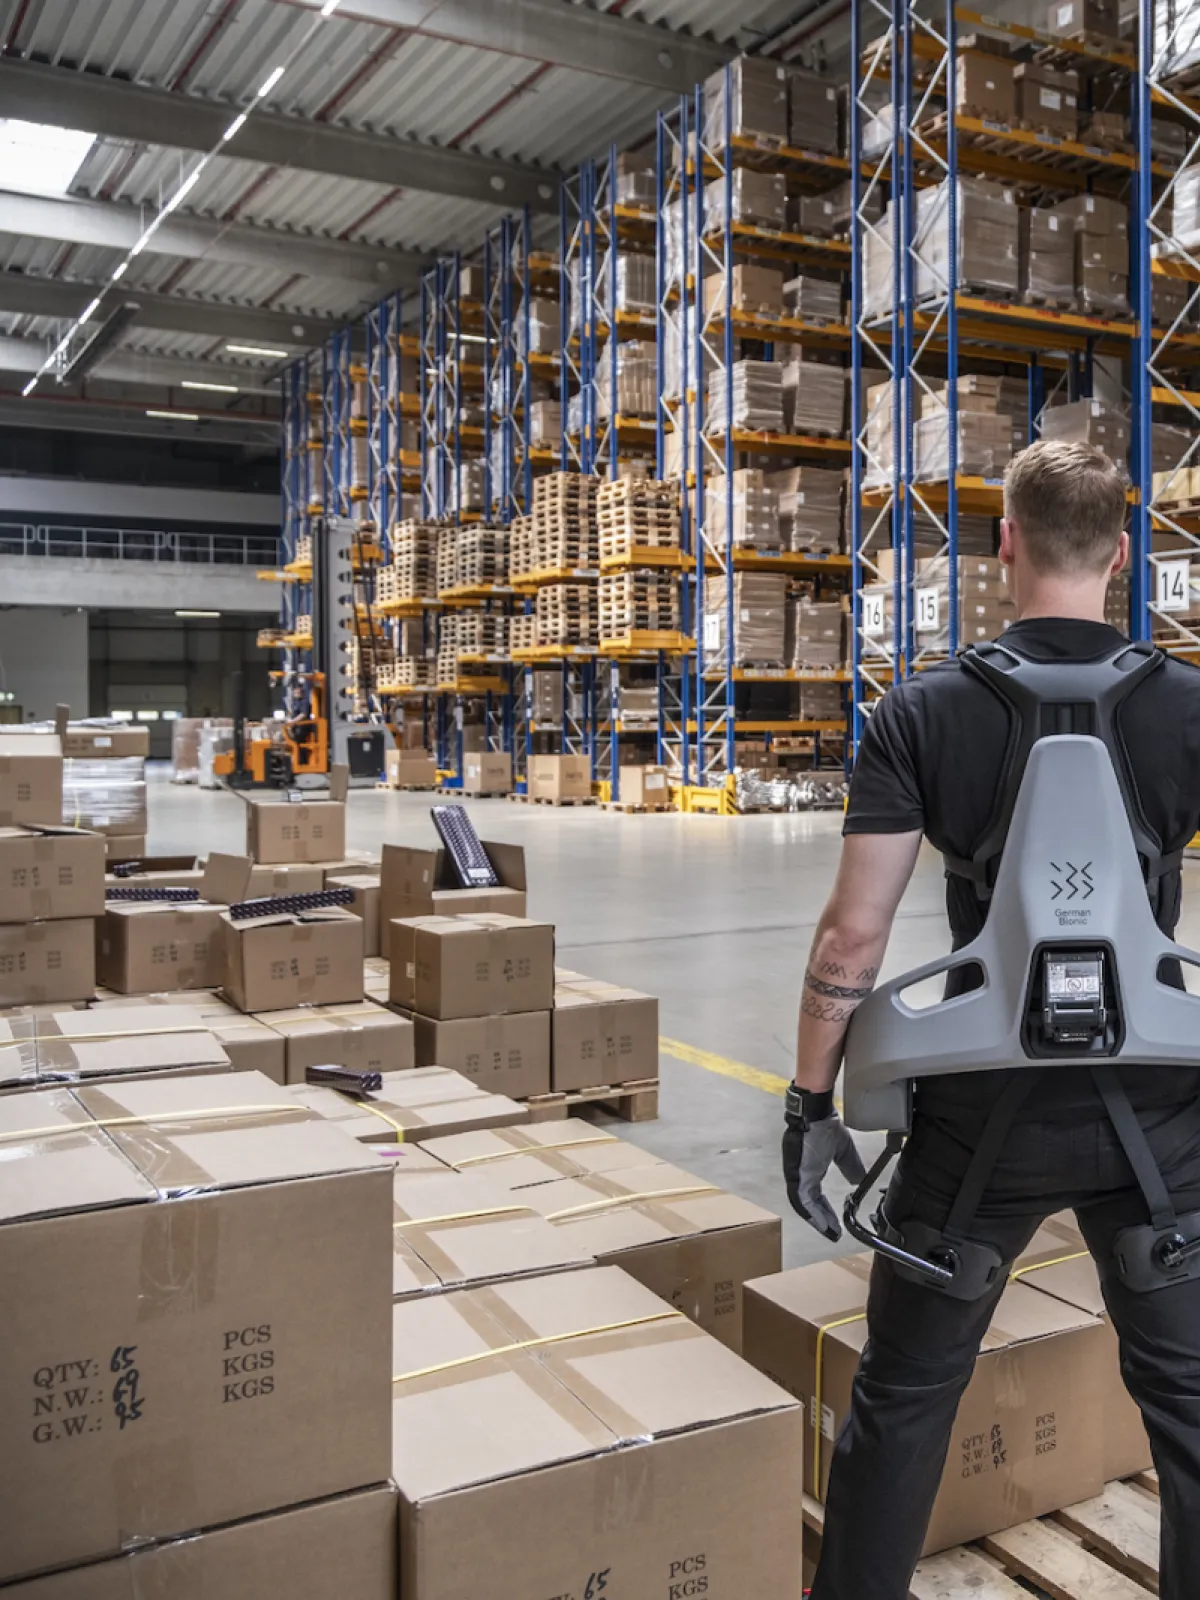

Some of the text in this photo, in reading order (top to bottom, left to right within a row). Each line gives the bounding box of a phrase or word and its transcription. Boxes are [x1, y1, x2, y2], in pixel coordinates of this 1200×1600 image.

[1161, 570, 1184, 601] 14
[866, 602, 881, 626] 16
[919, 595, 935, 622] 15
[1054, 908, 1091, 917] German
[1058, 917, 1088, 926] Bionic
[33, 1324, 272, 1389] QTY: 65 PCS
[33, 1387, 104, 1417] N.W.:
[222, 1351, 275, 1377] KGS
[32, 1415, 103, 1444] G.W.:
[222, 1376, 275, 1404] KGS
[1035, 1412, 1055, 1427] PCS
[1035, 1425, 1057, 1441] KGS
[1035, 1440, 1057, 1456] KGS
[583, 1554, 706, 1600] 65 PCS
[668, 1576, 709, 1600] KGS
